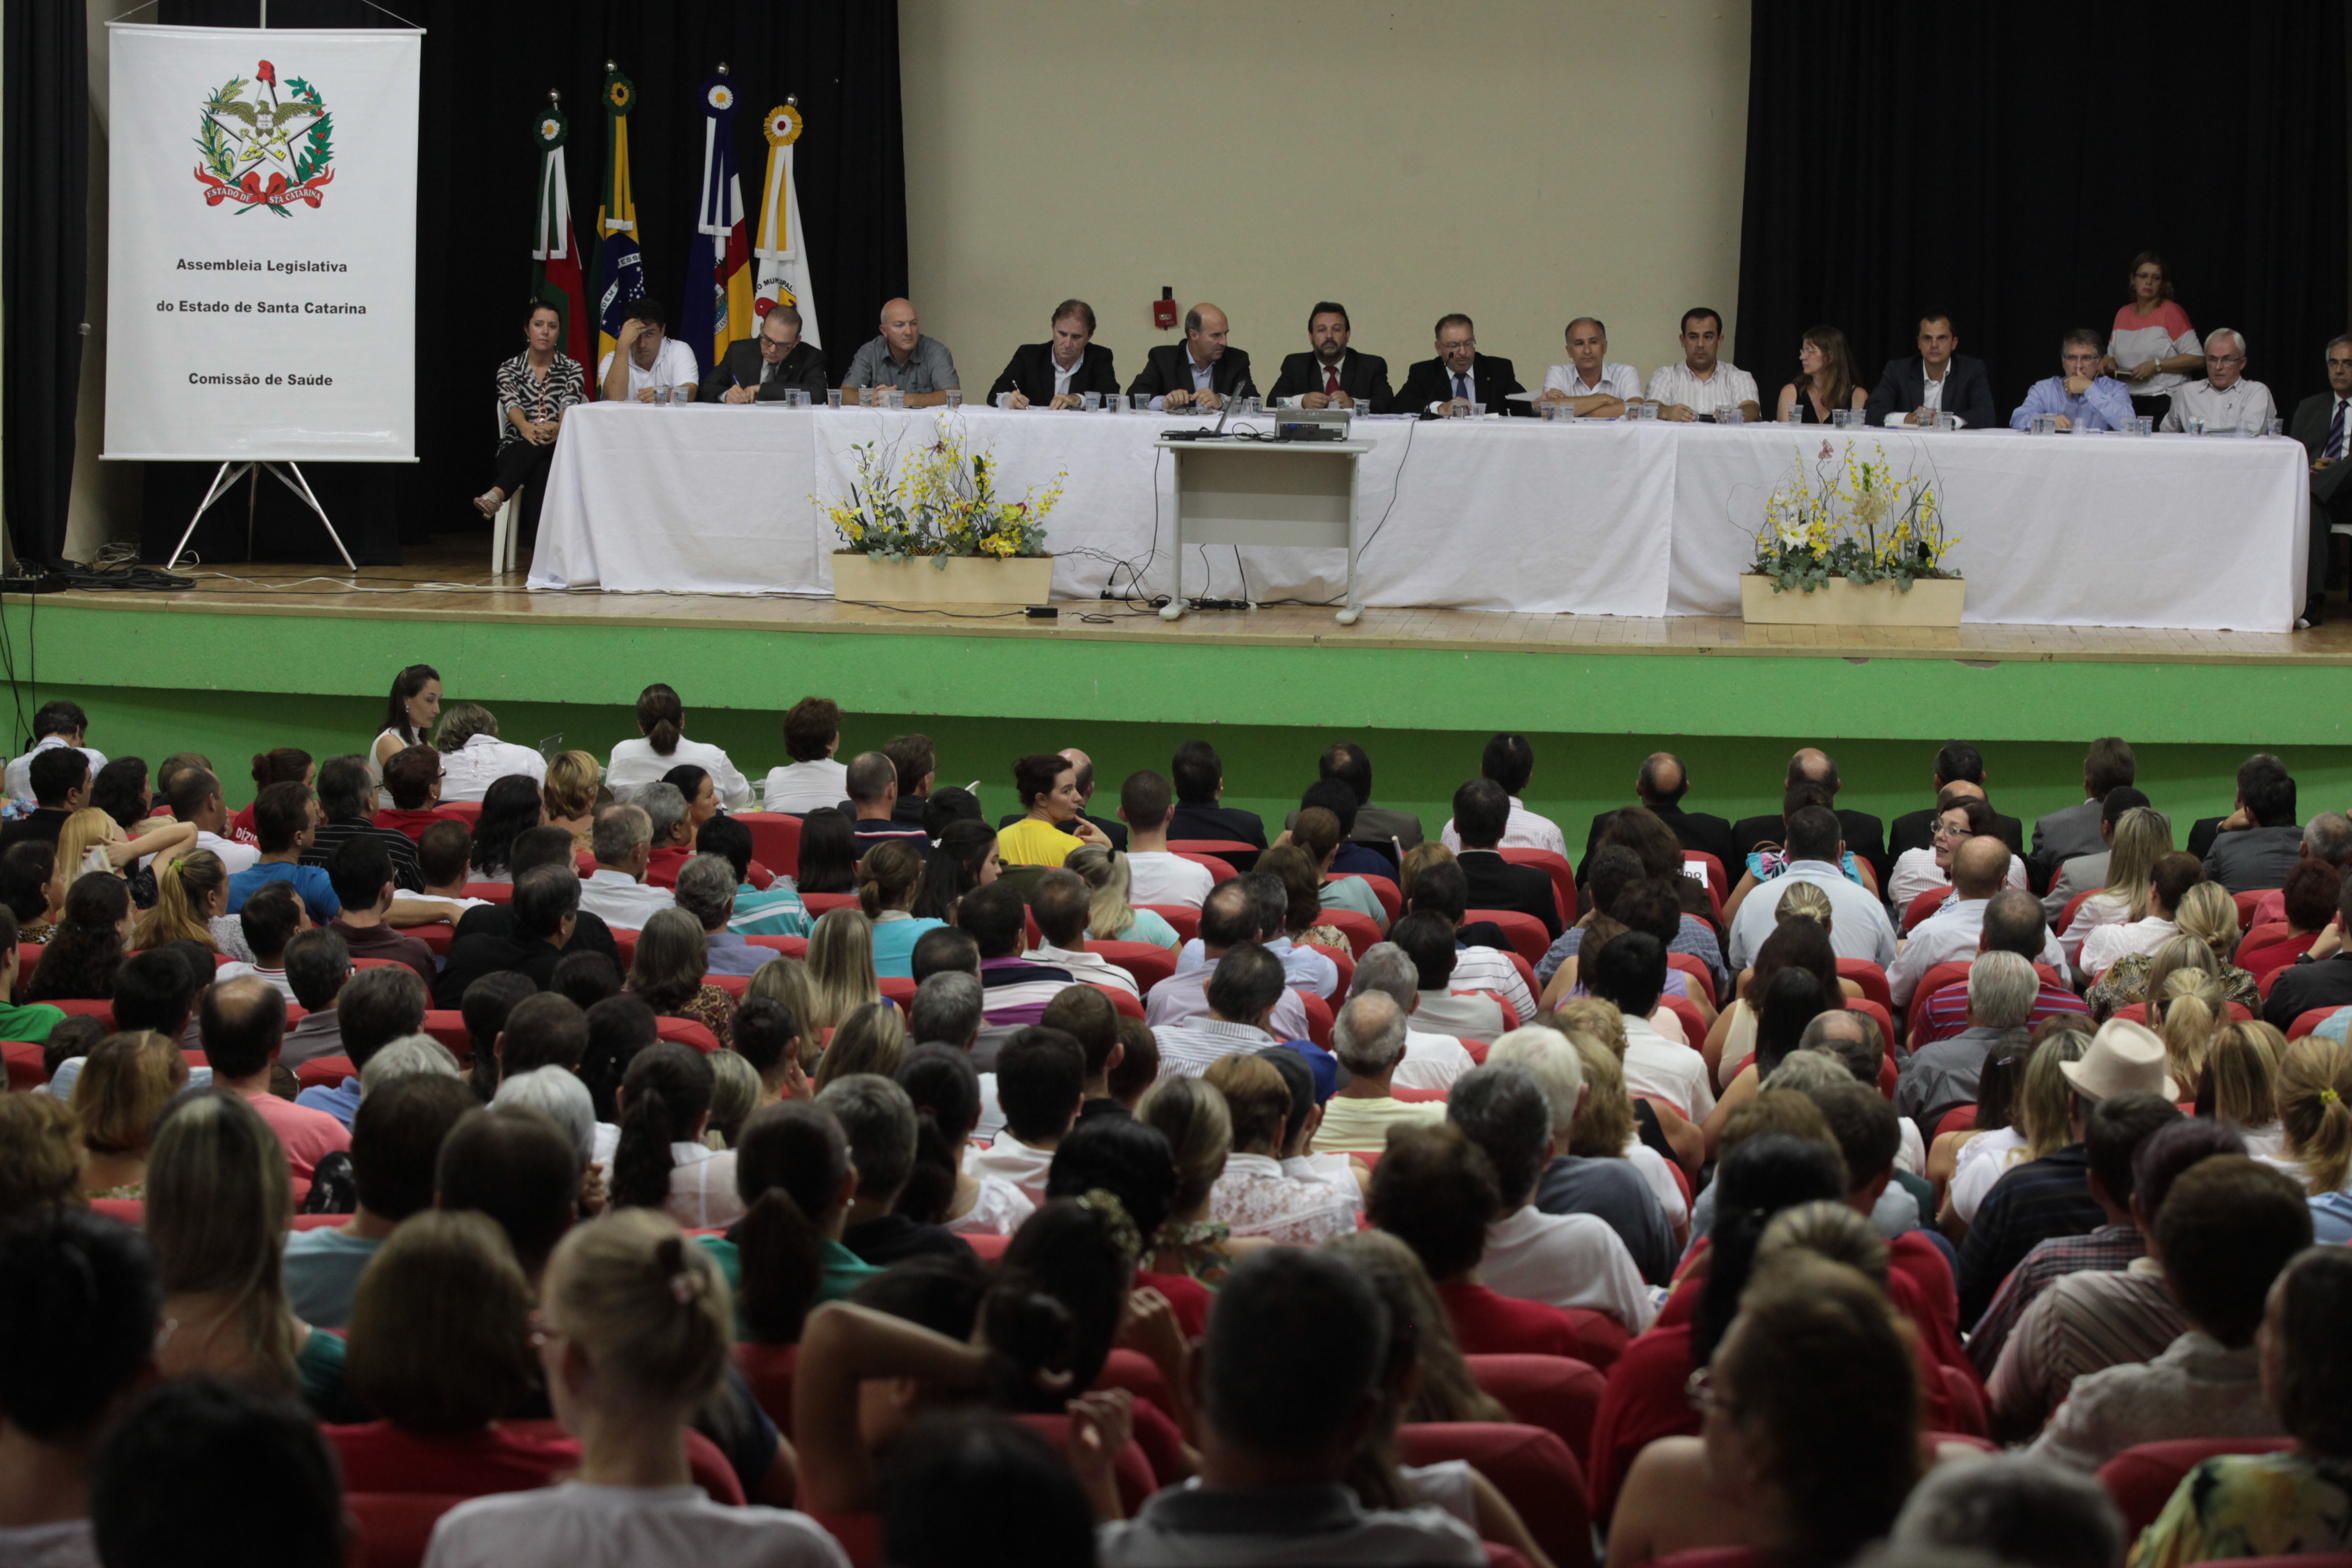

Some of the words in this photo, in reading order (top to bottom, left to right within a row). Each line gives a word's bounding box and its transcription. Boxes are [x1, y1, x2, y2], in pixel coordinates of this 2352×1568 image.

[207, 187, 239, 198] ESTADO
[240, 193, 251, 202] DE
[286, 189, 321, 201] CATARINA
[176, 258, 262, 271] Assembleia
[267, 260, 347, 274] Legislativa
[156, 300, 174, 312] do
[179, 300, 229, 312] Estado
[234, 301, 252, 312] de
[257, 301, 299, 314] Santa
[304, 302, 366, 314] Catarina
[189, 372, 260, 385] Comissão
[265, 374, 282, 385] de
[288, 374, 333, 386] Saúde
